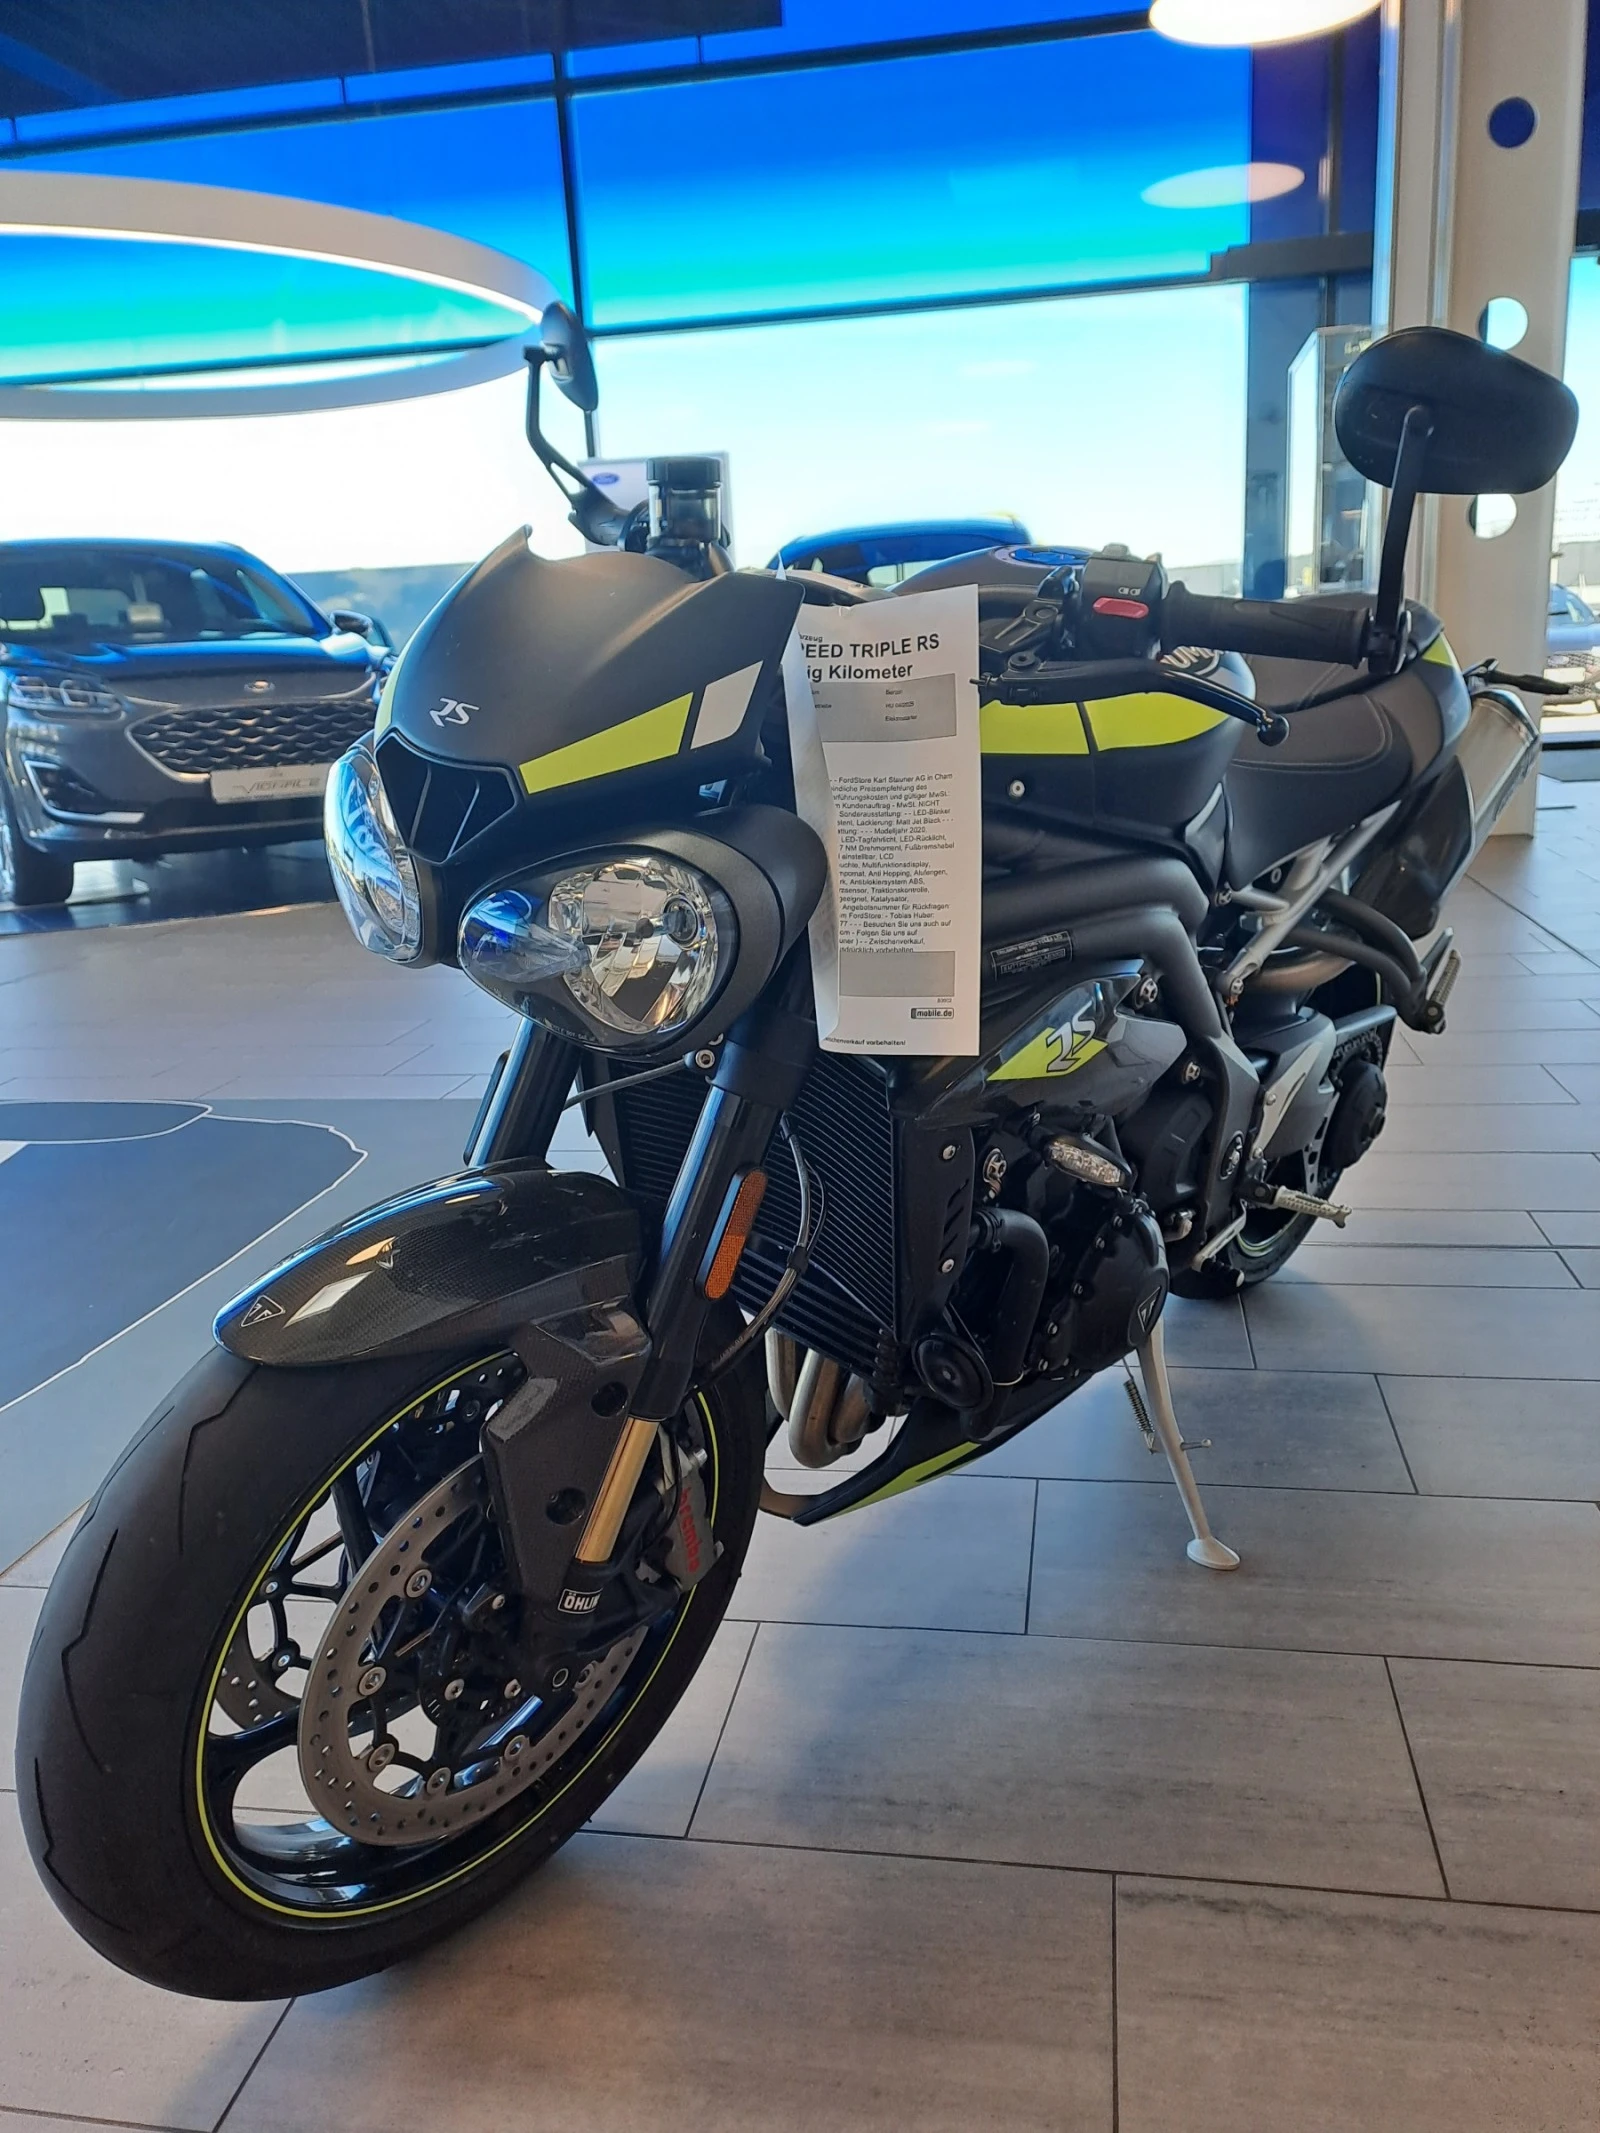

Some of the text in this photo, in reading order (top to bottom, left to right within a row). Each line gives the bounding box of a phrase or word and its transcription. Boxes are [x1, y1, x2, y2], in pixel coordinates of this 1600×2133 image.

[801, 634, 939, 658] EED TRIPLE RS
[829, 665, 912, 679] Kilometer
[428, 697, 481, 729] RS
[842, 802, 890, 810] Kundenauftrag
[905, 843, 955, 851] Fußbremshebel
